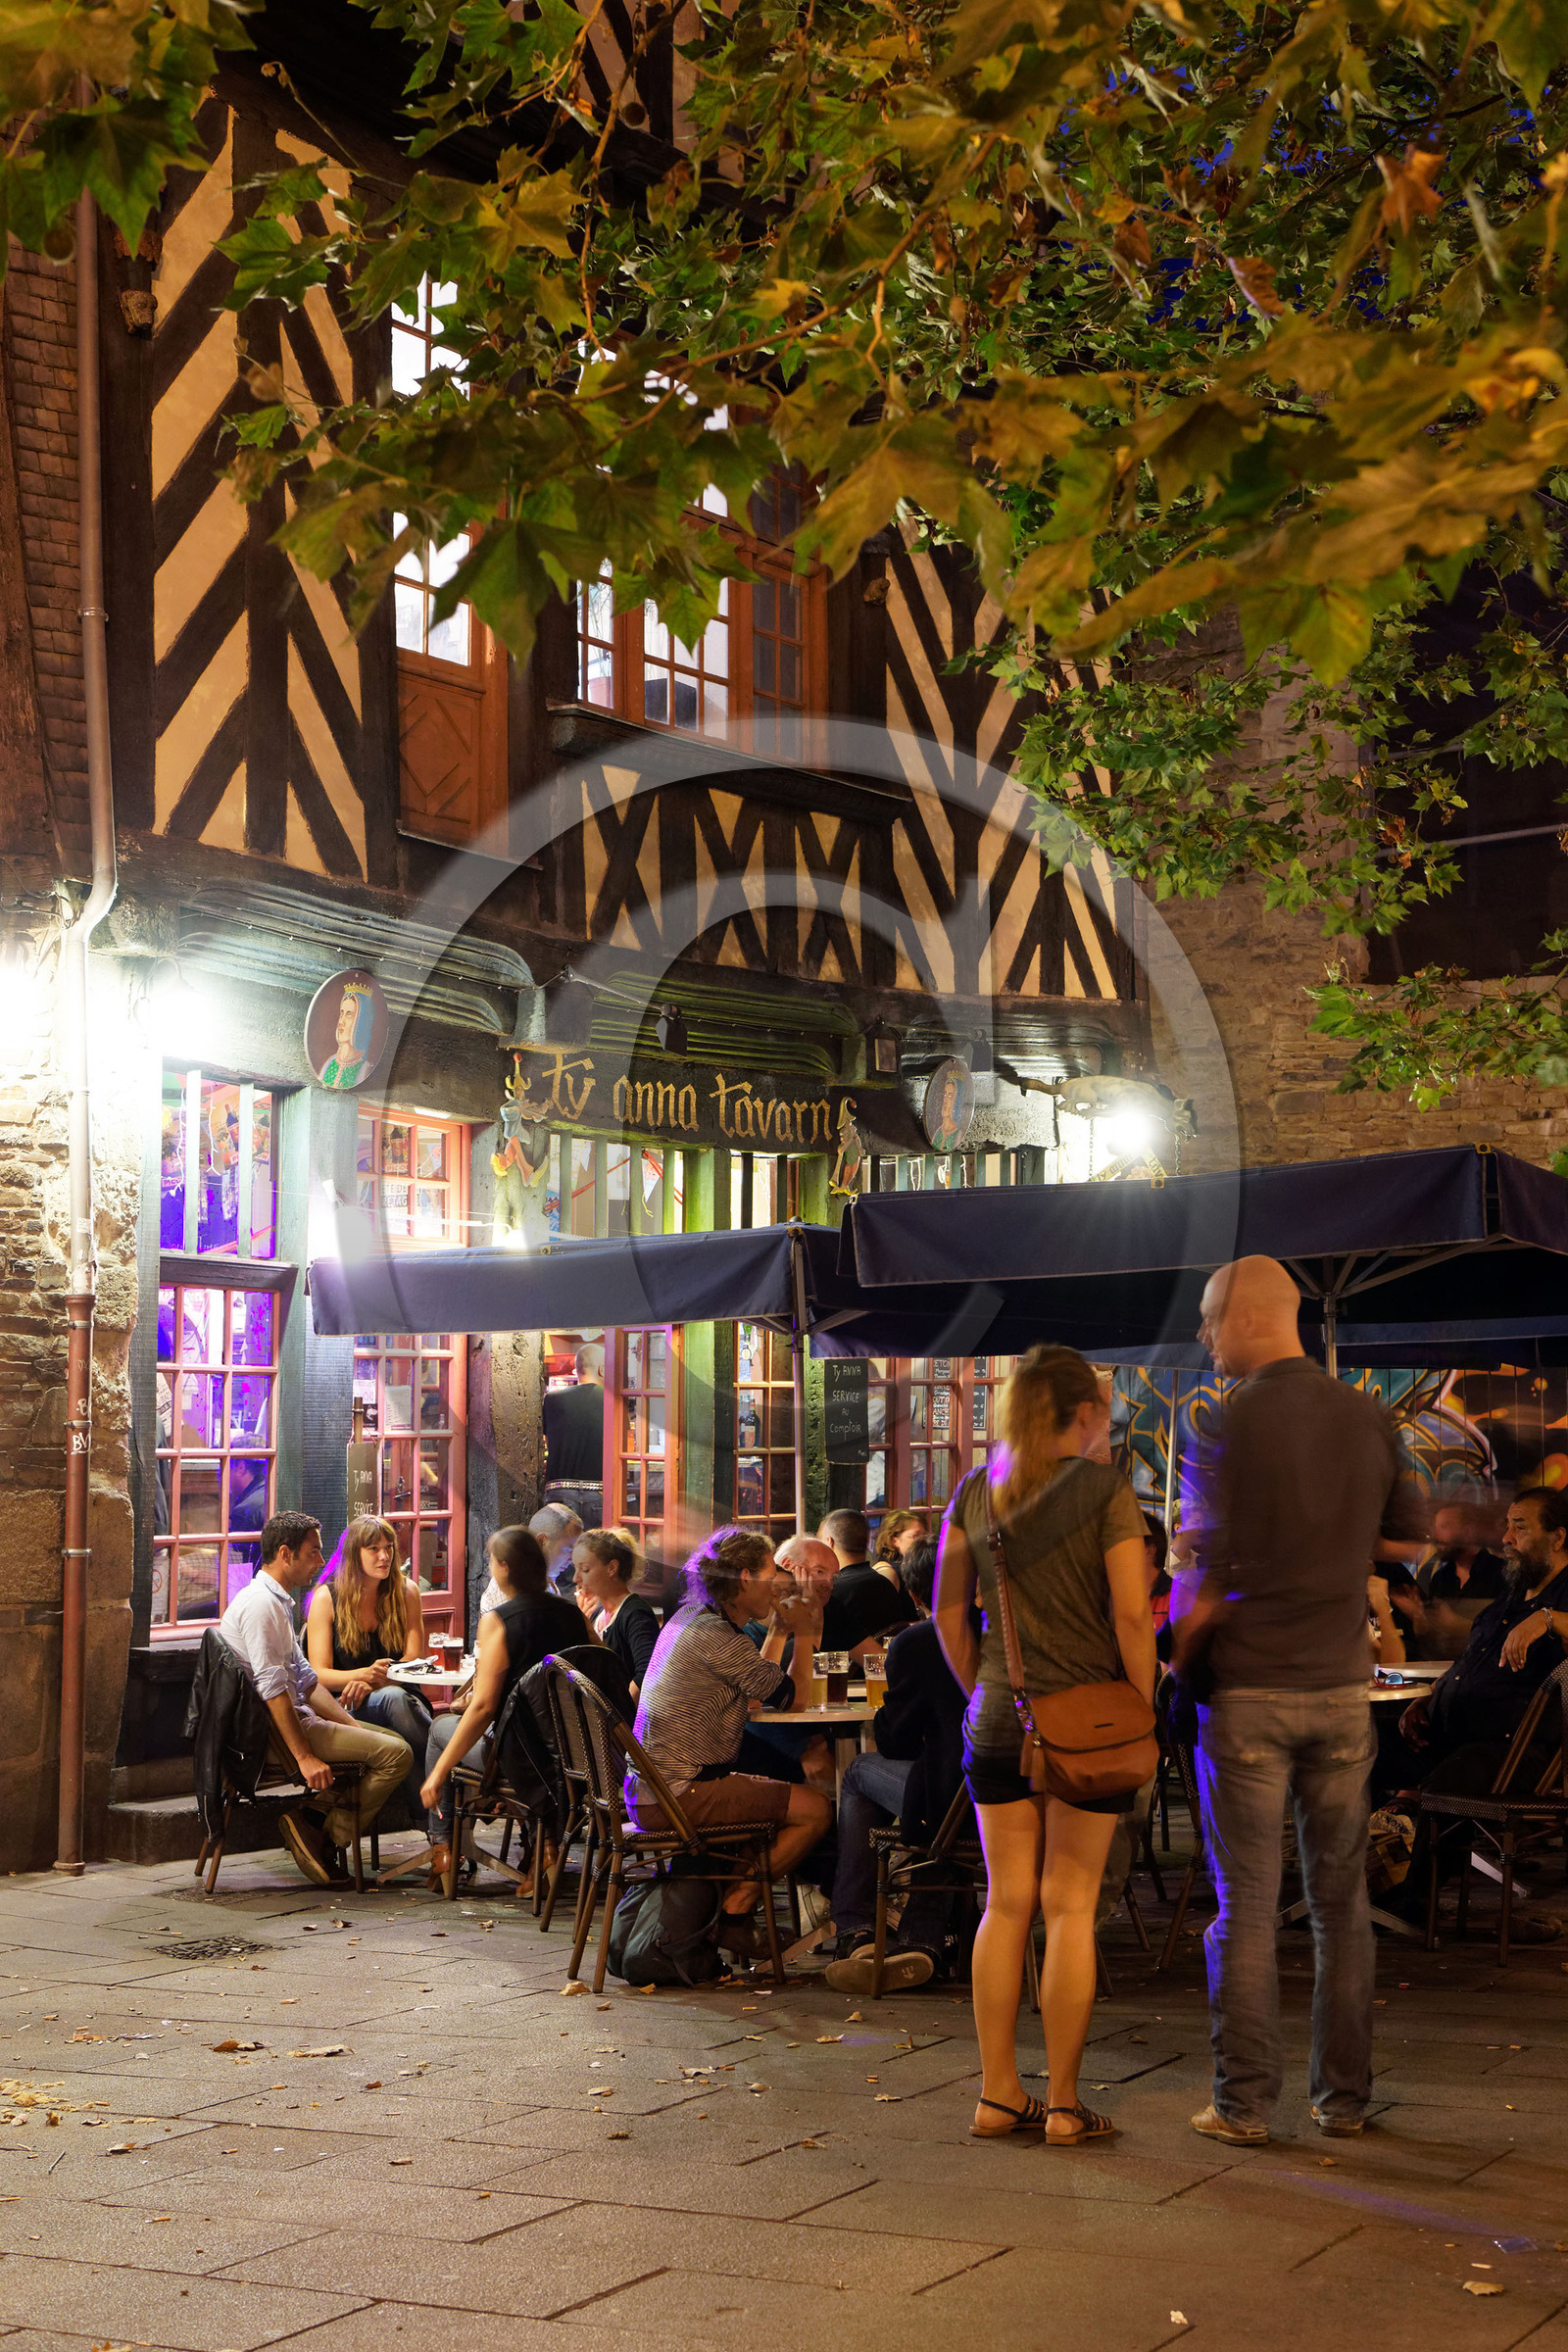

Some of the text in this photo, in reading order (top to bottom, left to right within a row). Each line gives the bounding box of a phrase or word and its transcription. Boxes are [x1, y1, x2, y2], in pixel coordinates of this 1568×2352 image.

[613, 1074, 700, 1133] anna
[709, 1072, 833, 1145] tavarn
[832, 1364, 841, 1383] Ty
